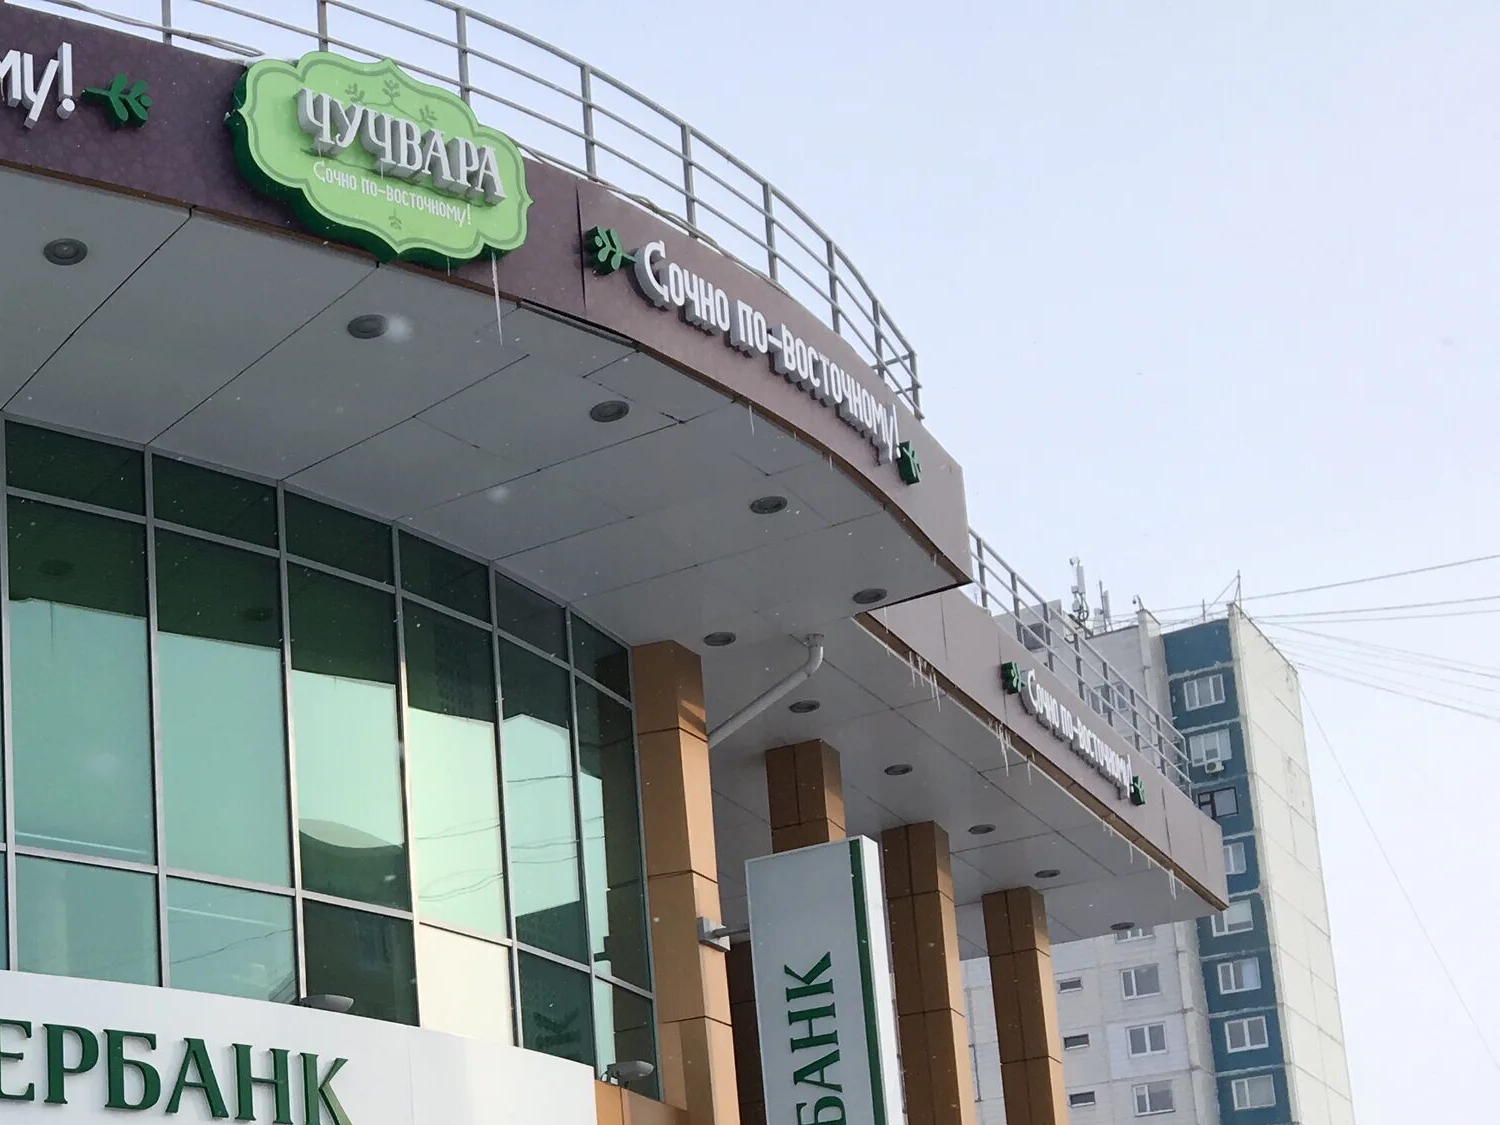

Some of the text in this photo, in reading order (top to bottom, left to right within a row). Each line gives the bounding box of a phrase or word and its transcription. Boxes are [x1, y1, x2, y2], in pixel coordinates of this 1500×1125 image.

[298, 87, 508, 206] ЧУЧВАРА
[313, 160, 472, 228] Сочно по-восточному!
[637, 240, 901, 465] Сочно по-восточному!
